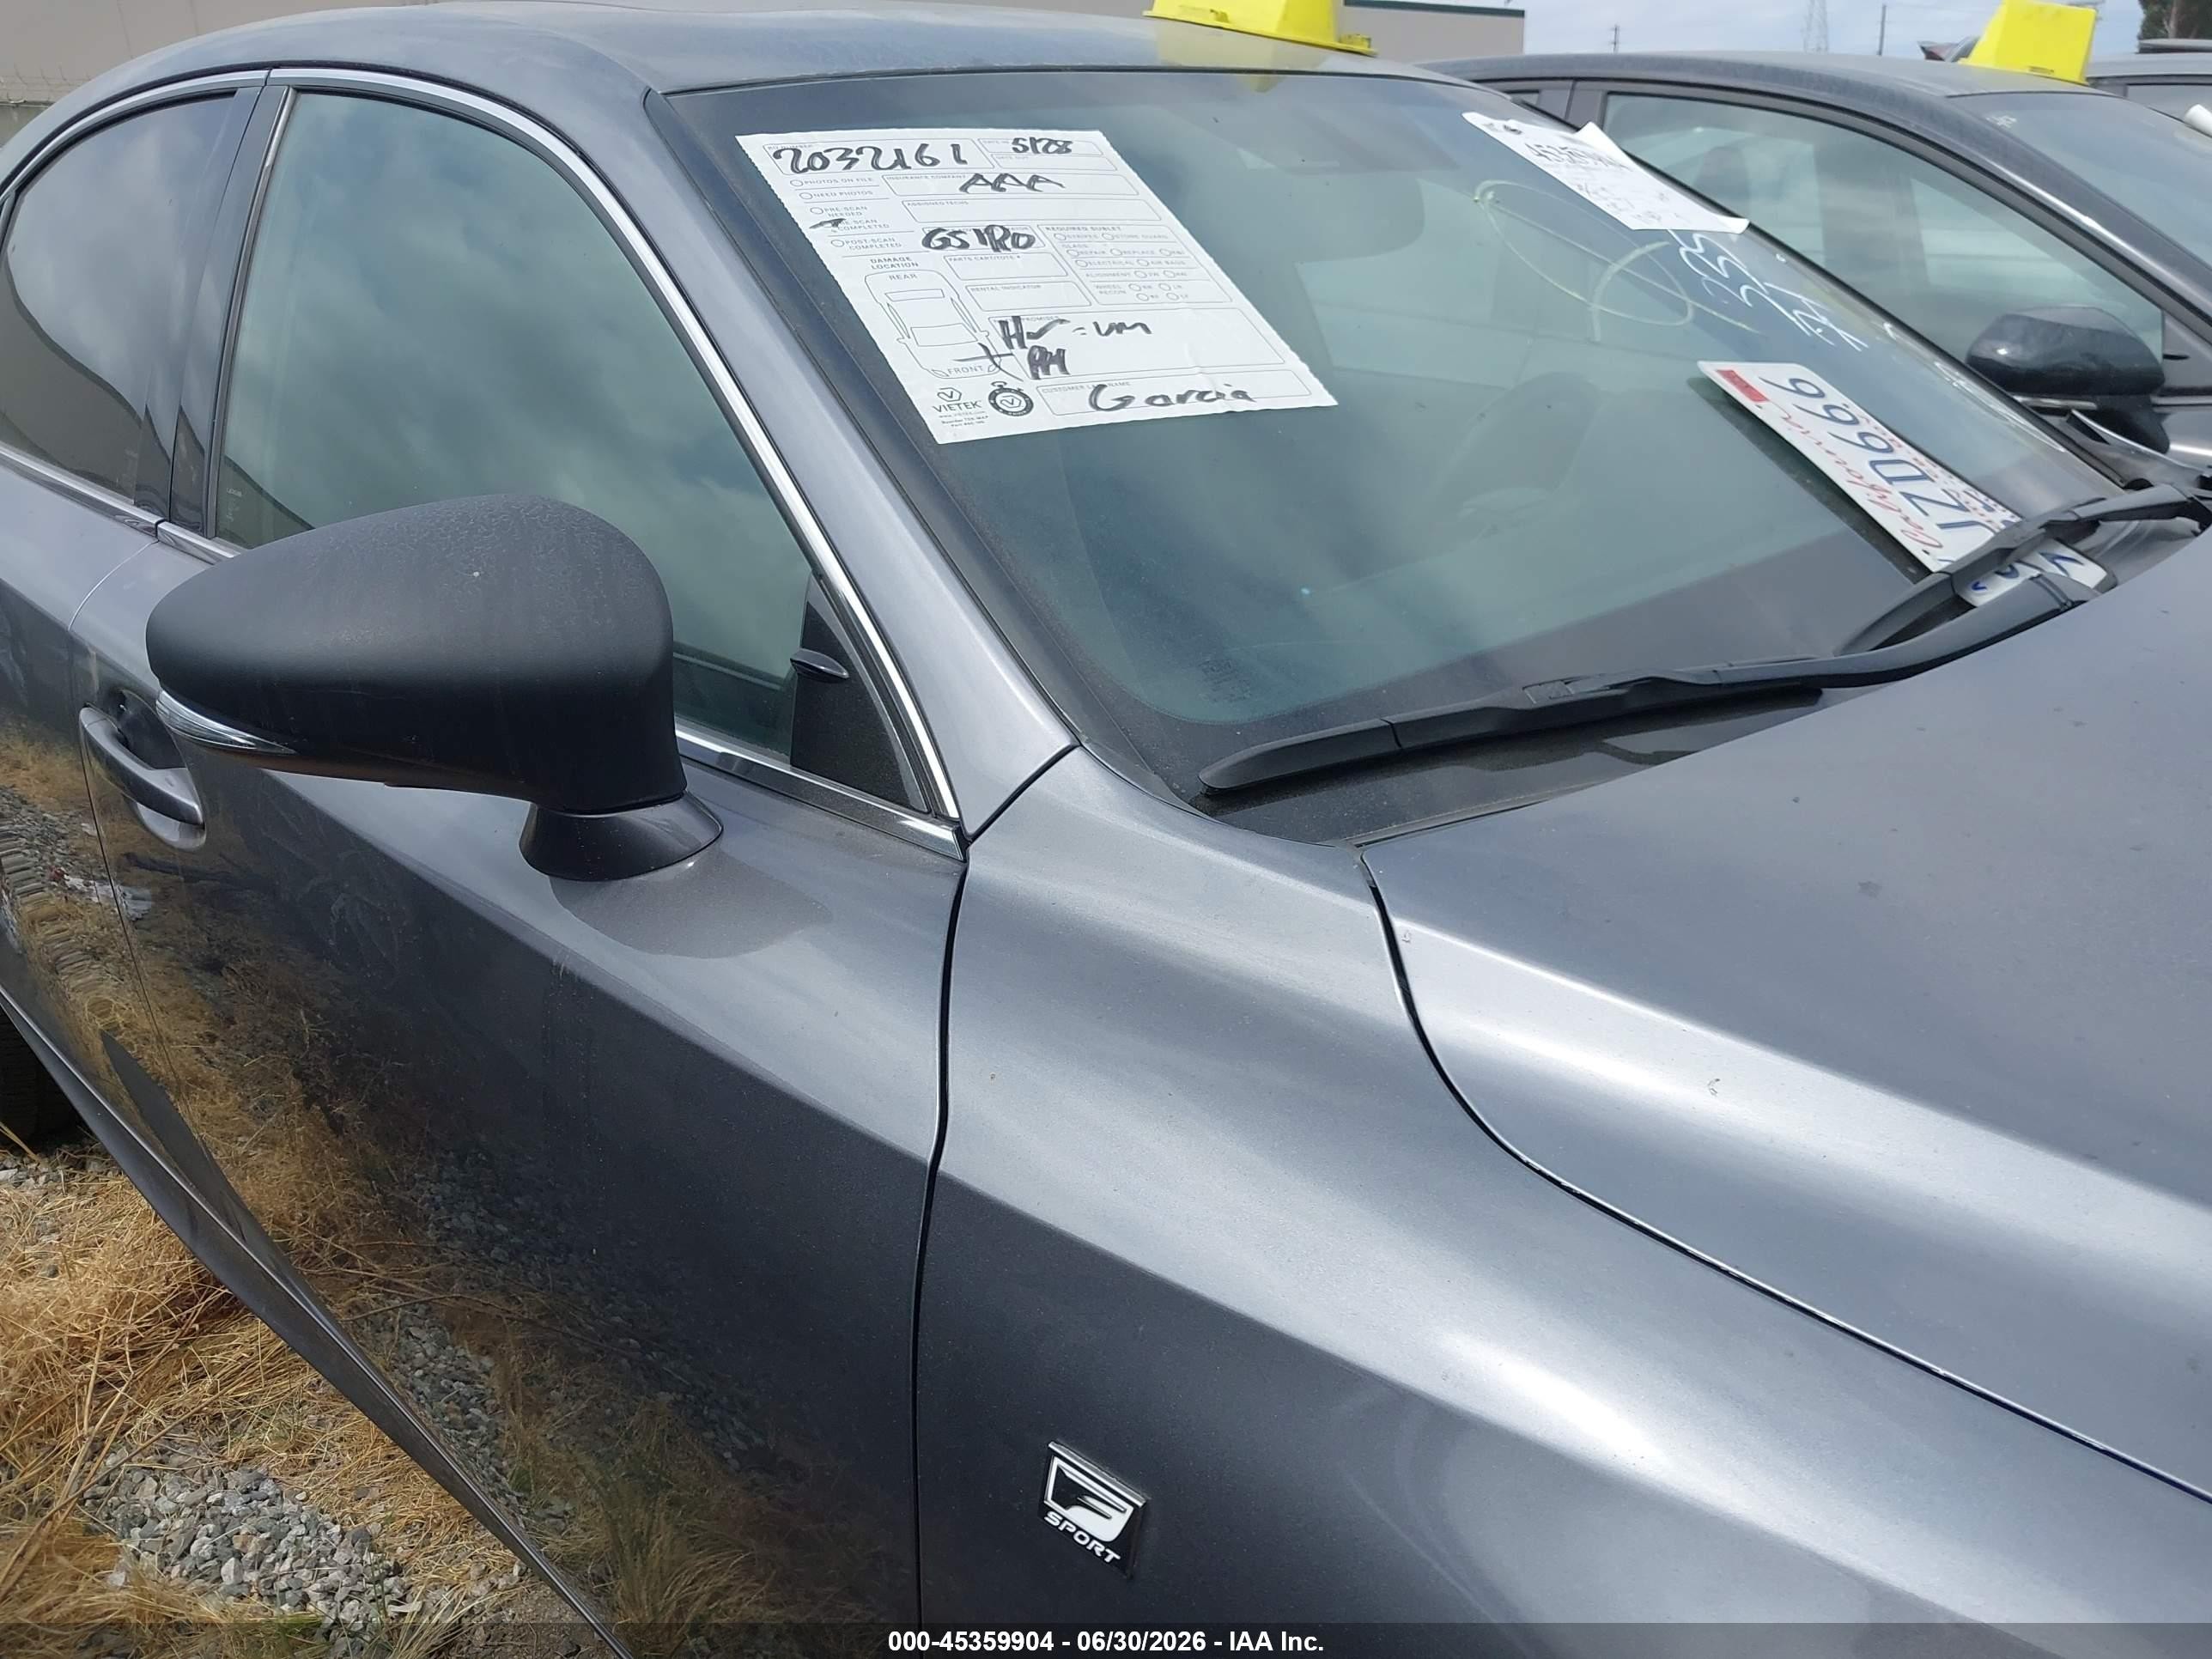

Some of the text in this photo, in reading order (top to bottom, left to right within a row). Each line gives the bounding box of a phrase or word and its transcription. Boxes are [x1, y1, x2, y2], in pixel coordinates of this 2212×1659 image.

[947, 365, 984, 375] FRONT
[933, 401, 982, 413] VIETEK
[1090, 383, 1256, 411] Garcia
[1770, 401, 1943, 549] California
[1043, 1510, 1121, 1564] SPORT
